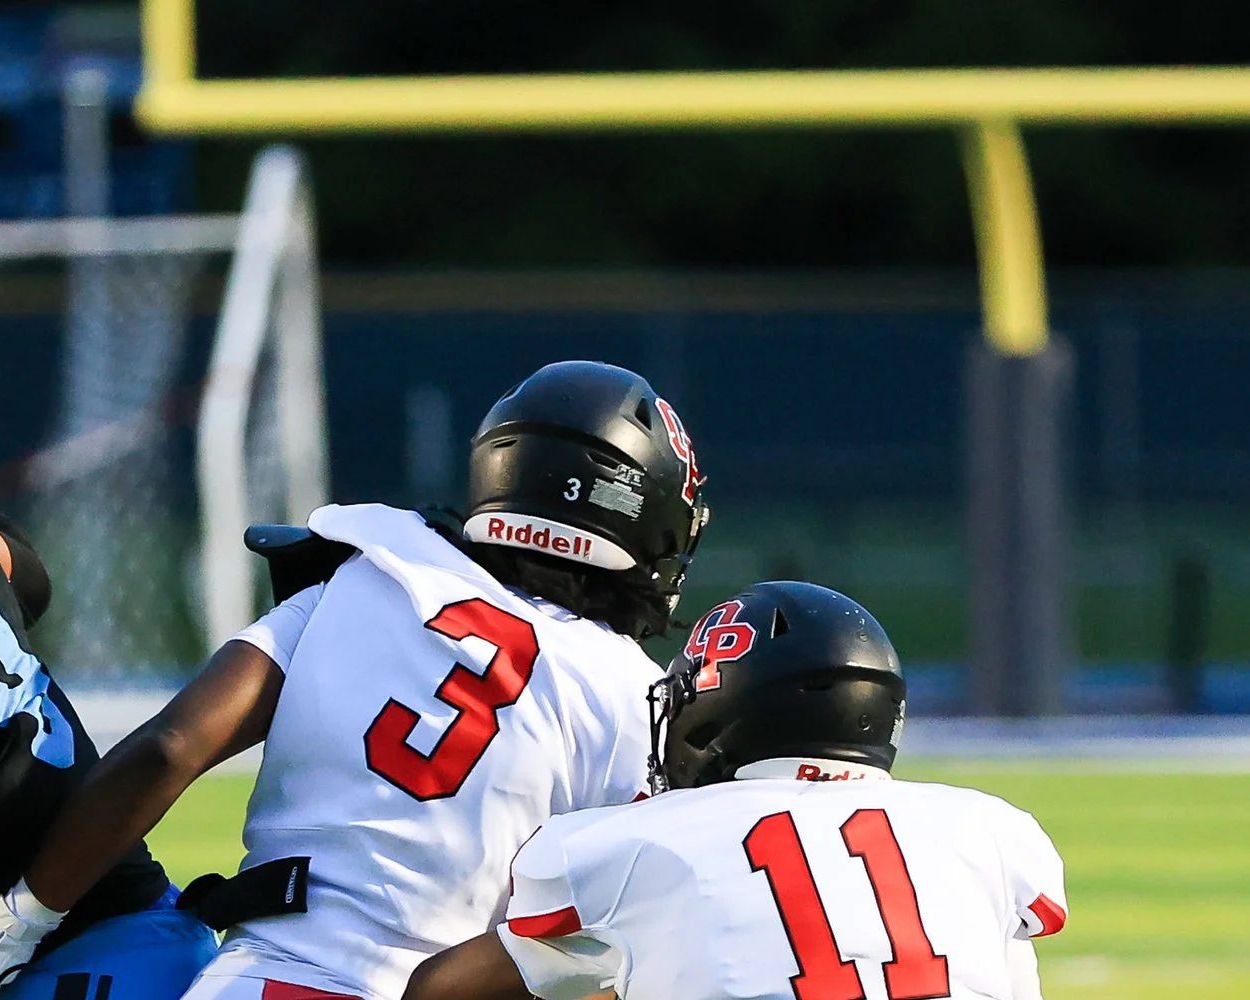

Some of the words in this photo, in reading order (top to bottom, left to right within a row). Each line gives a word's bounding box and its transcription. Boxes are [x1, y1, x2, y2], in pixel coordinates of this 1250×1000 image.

[563, 477, 582, 502] 3
[487, 517, 592, 560] Riddell
[362, 597, 541, 803] 3
